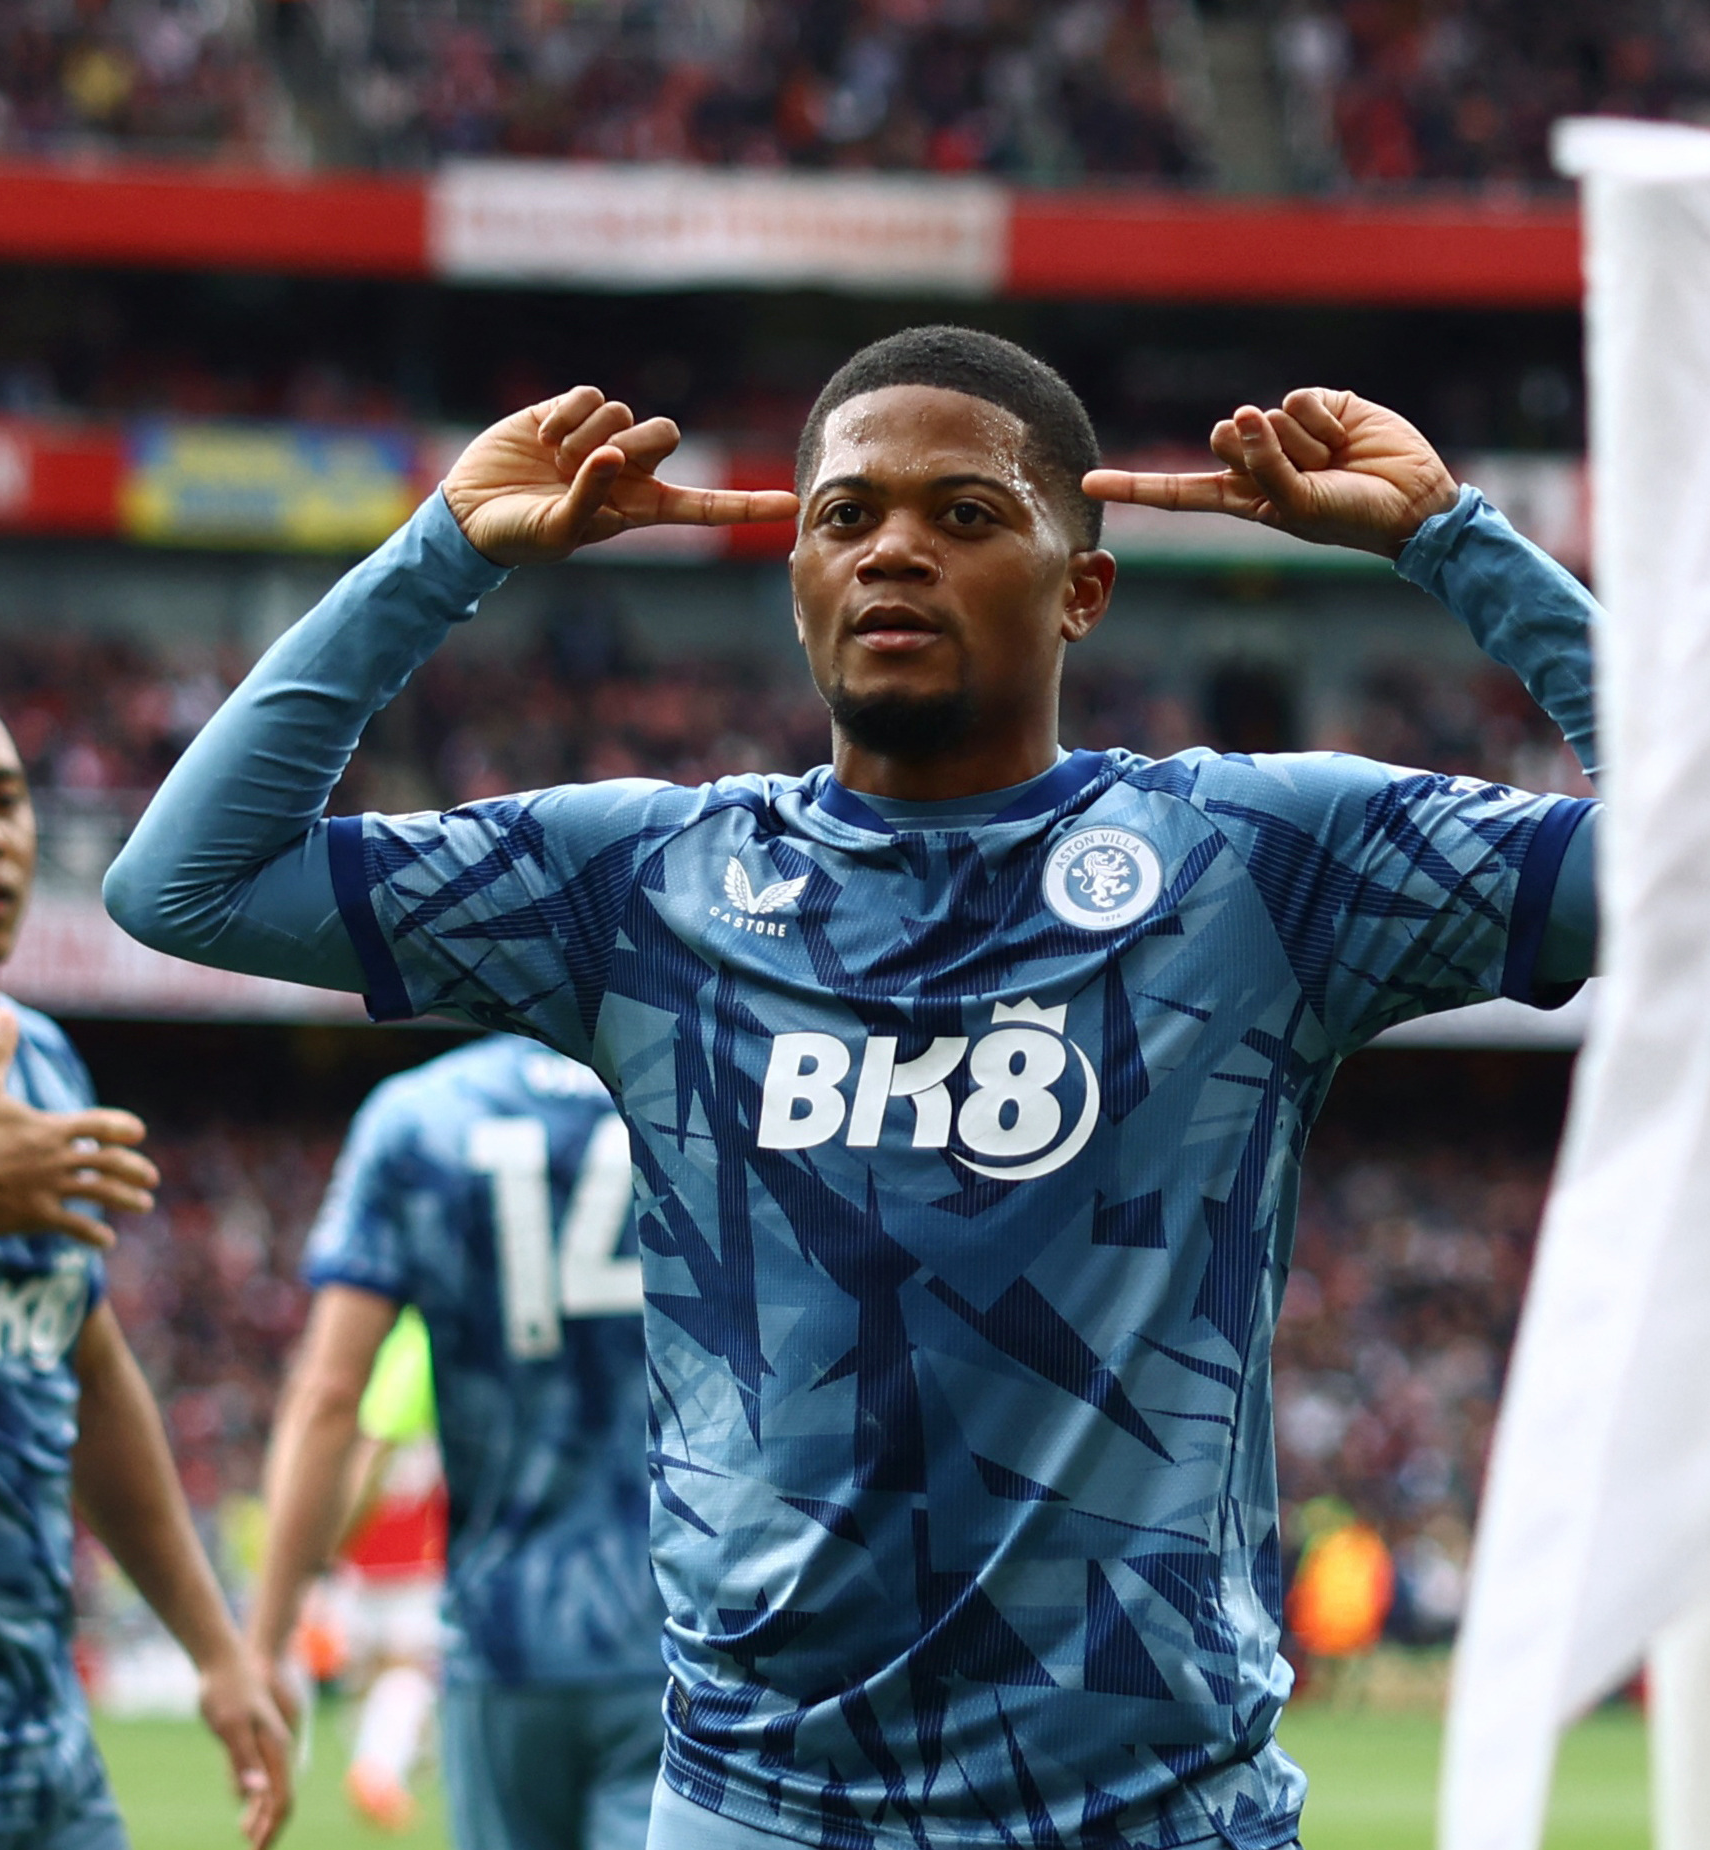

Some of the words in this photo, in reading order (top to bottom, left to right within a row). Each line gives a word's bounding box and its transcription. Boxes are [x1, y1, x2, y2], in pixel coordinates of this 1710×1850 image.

[1055, 834, 1095, 870] ASTON
[1100, 832, 1141, 855] VILLA
[709, 906, 787, 938] CASTORE
[757, 1027, 1068, 1157] BK8
